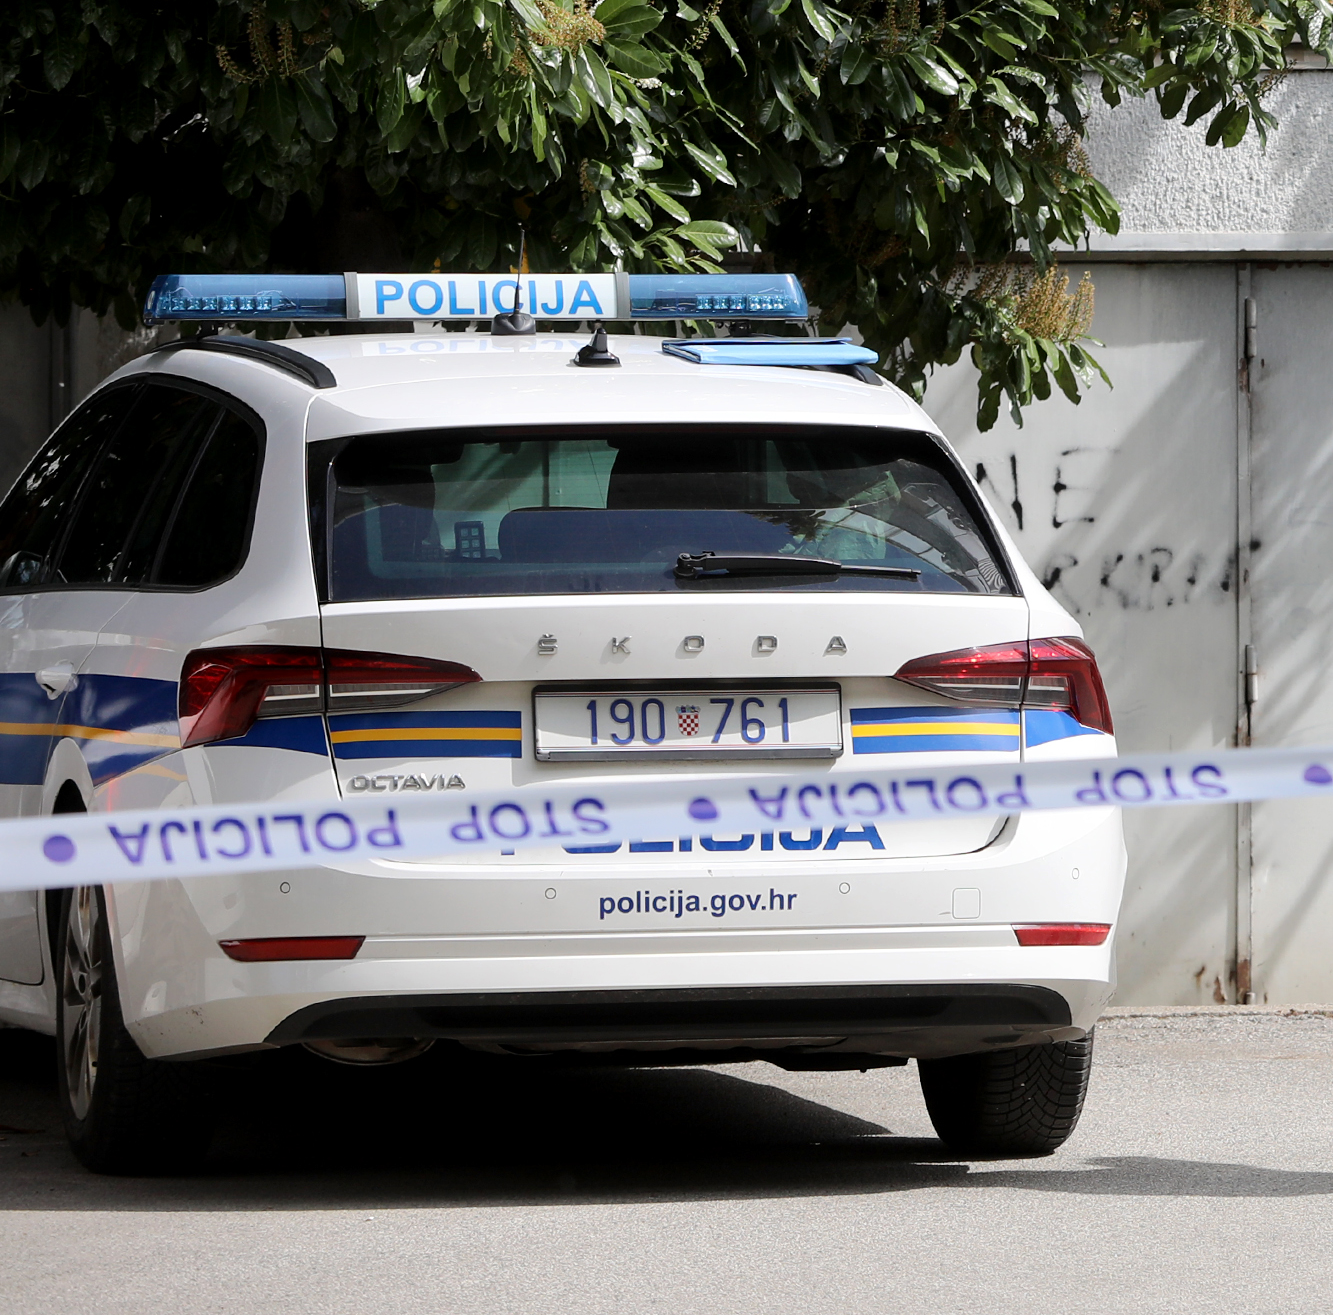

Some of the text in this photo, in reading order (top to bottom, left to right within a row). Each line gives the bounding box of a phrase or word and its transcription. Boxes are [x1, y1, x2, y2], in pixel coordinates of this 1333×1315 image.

[375, 279, 604, 316] POLICIJA
[537, 633, 848, 656] ŠKODA
[587, 697, 790, 745] 190 761
[350, 773, 466, 791] OCTAVIA
[748, 773, 1031, 821] POLICIJA
[1075, 763, 1228, 801] STOP
[108, 809, 403, 864] POLICIJA
[450, 797, 613, 845] STOP
[599, 888, 798, 919] policija.gov.hr
